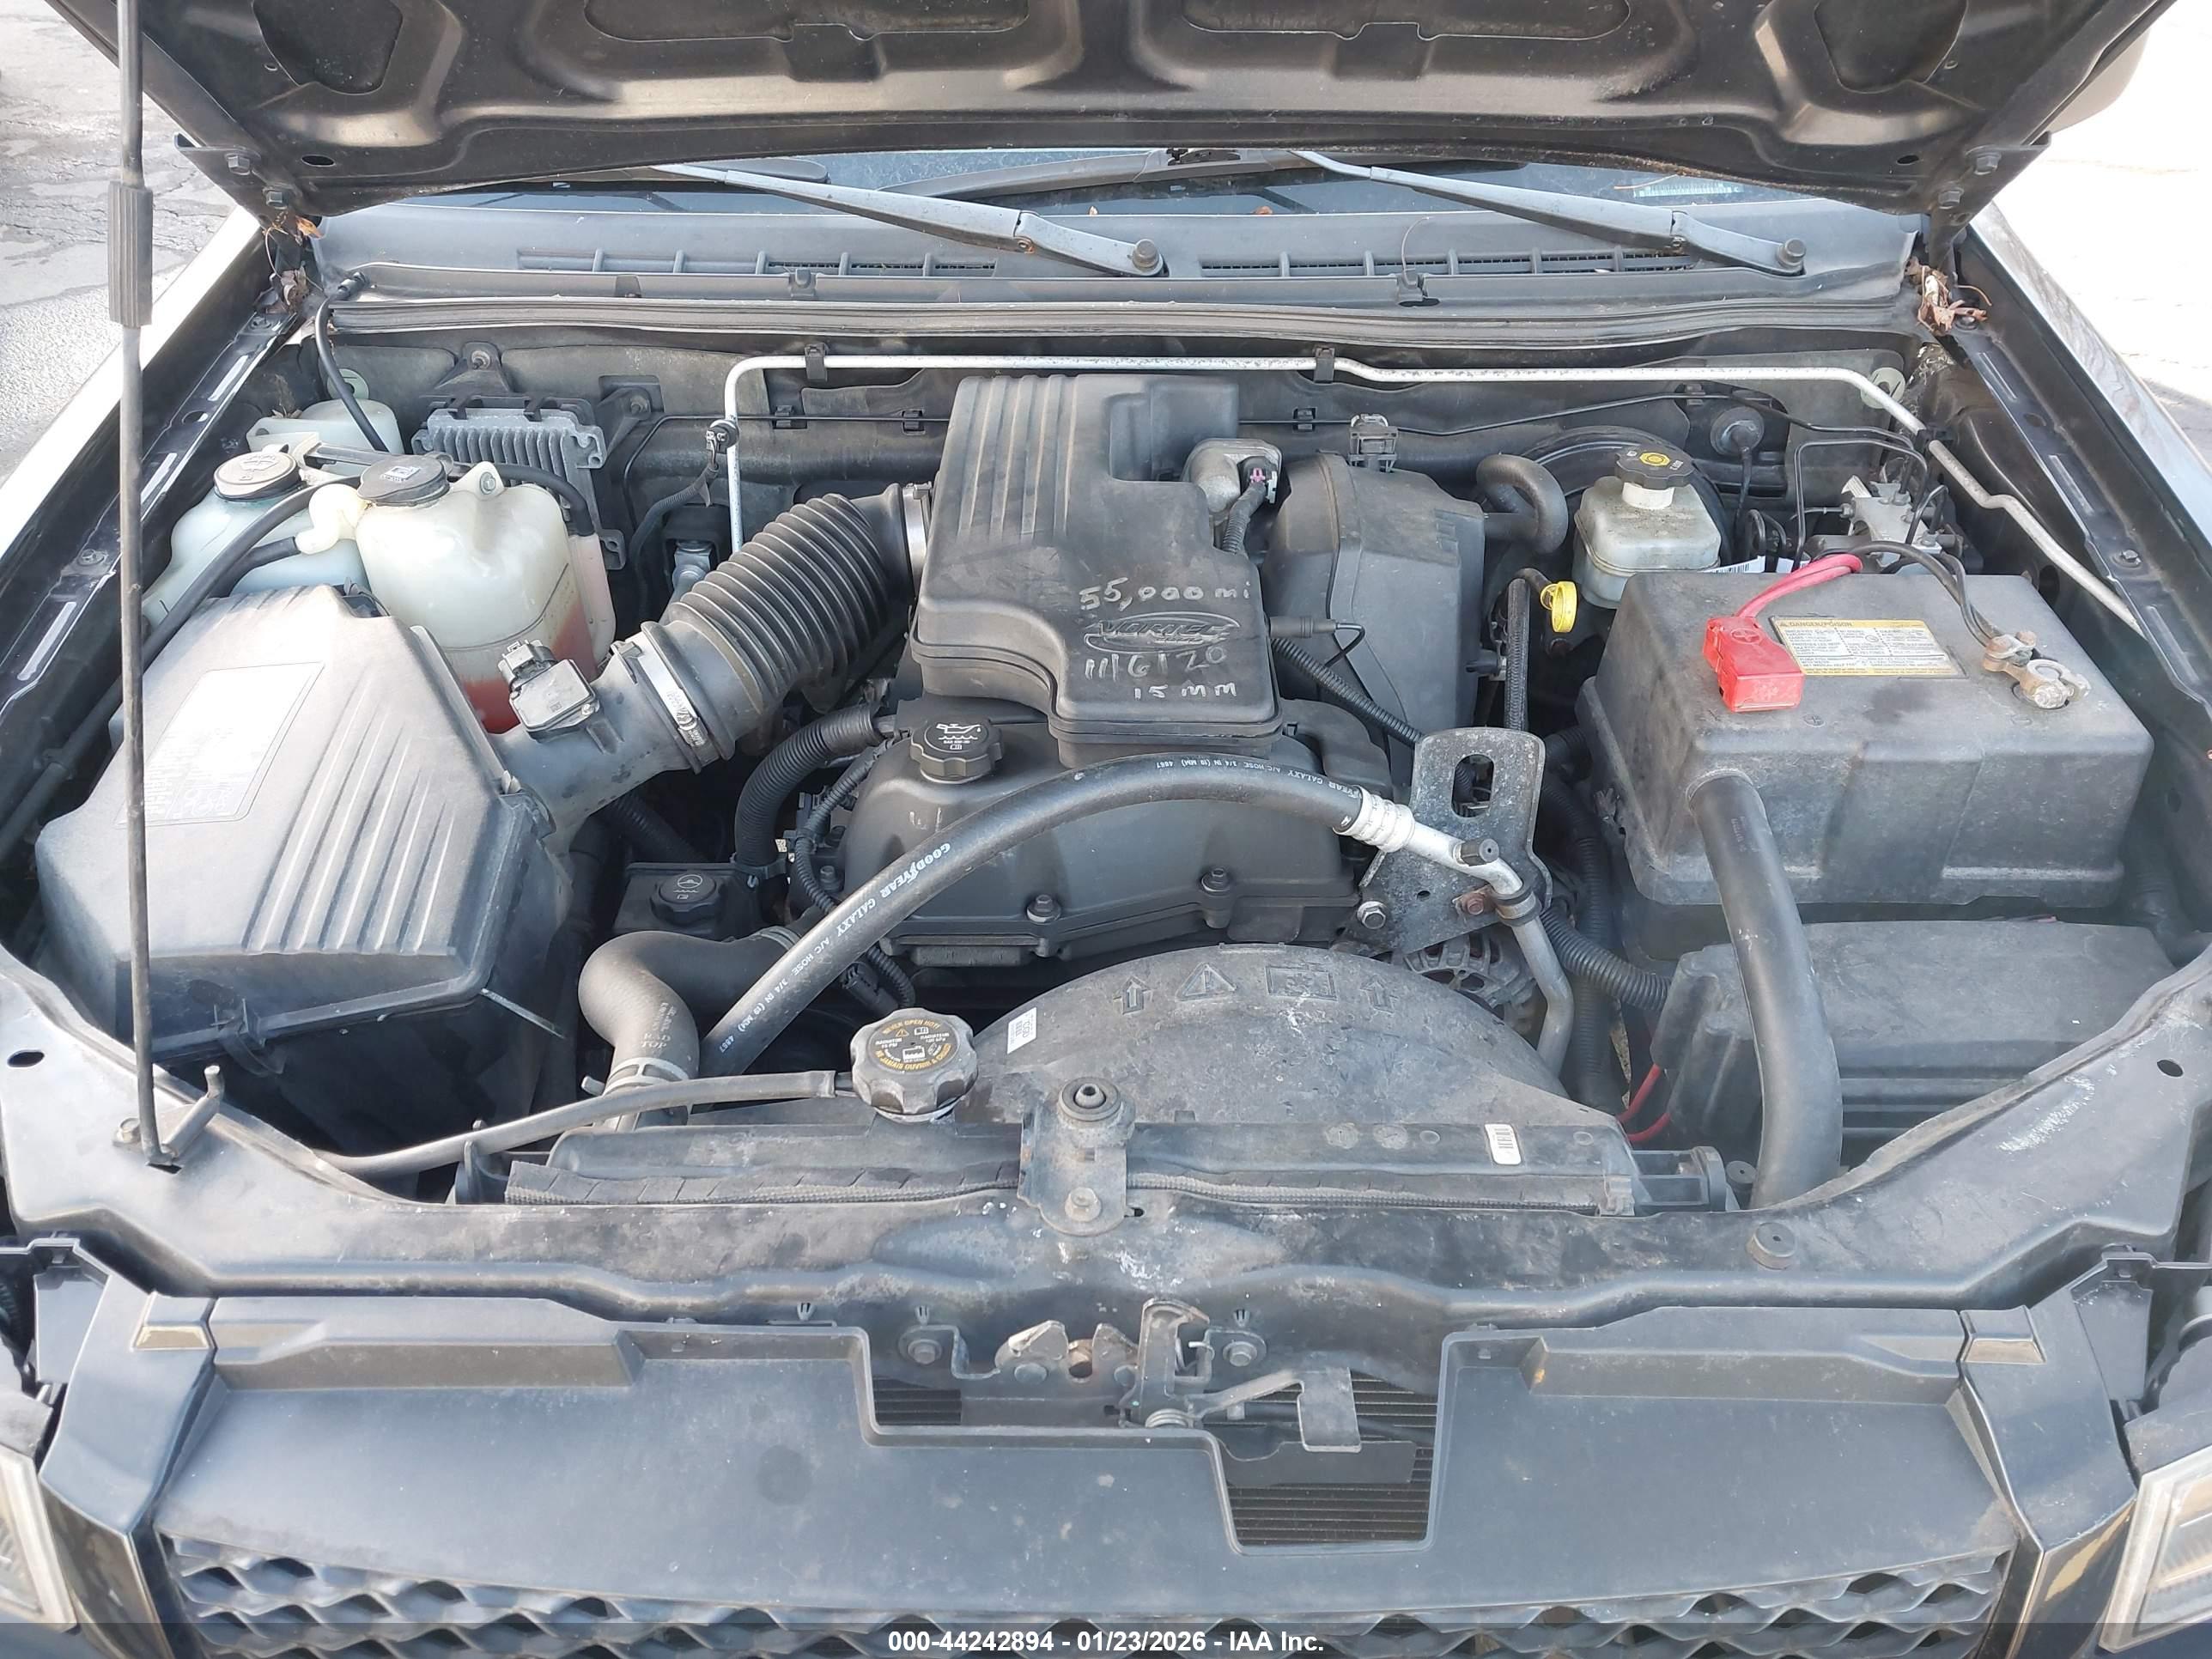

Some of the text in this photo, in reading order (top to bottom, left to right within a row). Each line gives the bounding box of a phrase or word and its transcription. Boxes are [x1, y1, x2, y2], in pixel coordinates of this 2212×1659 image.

[1079, 577, 1251, 611] 55,000 mi
[1134, 684, 1168, 700] 15
[1243, 762, 1265, 770] HOSE
[1288, 770, 1323, 785] GALAXY
[880, 842, 951, 898] GOODYEAR
[836, 898, 876, 937] GALAXY
[815, 937, 830, 954] A/C
[791, 953, 814, 976] HOSE
[775, 978, 788, 993] 3/4
[764, 993, 775, 1004] IN
[738, 1015, 753, 1032] MM)
